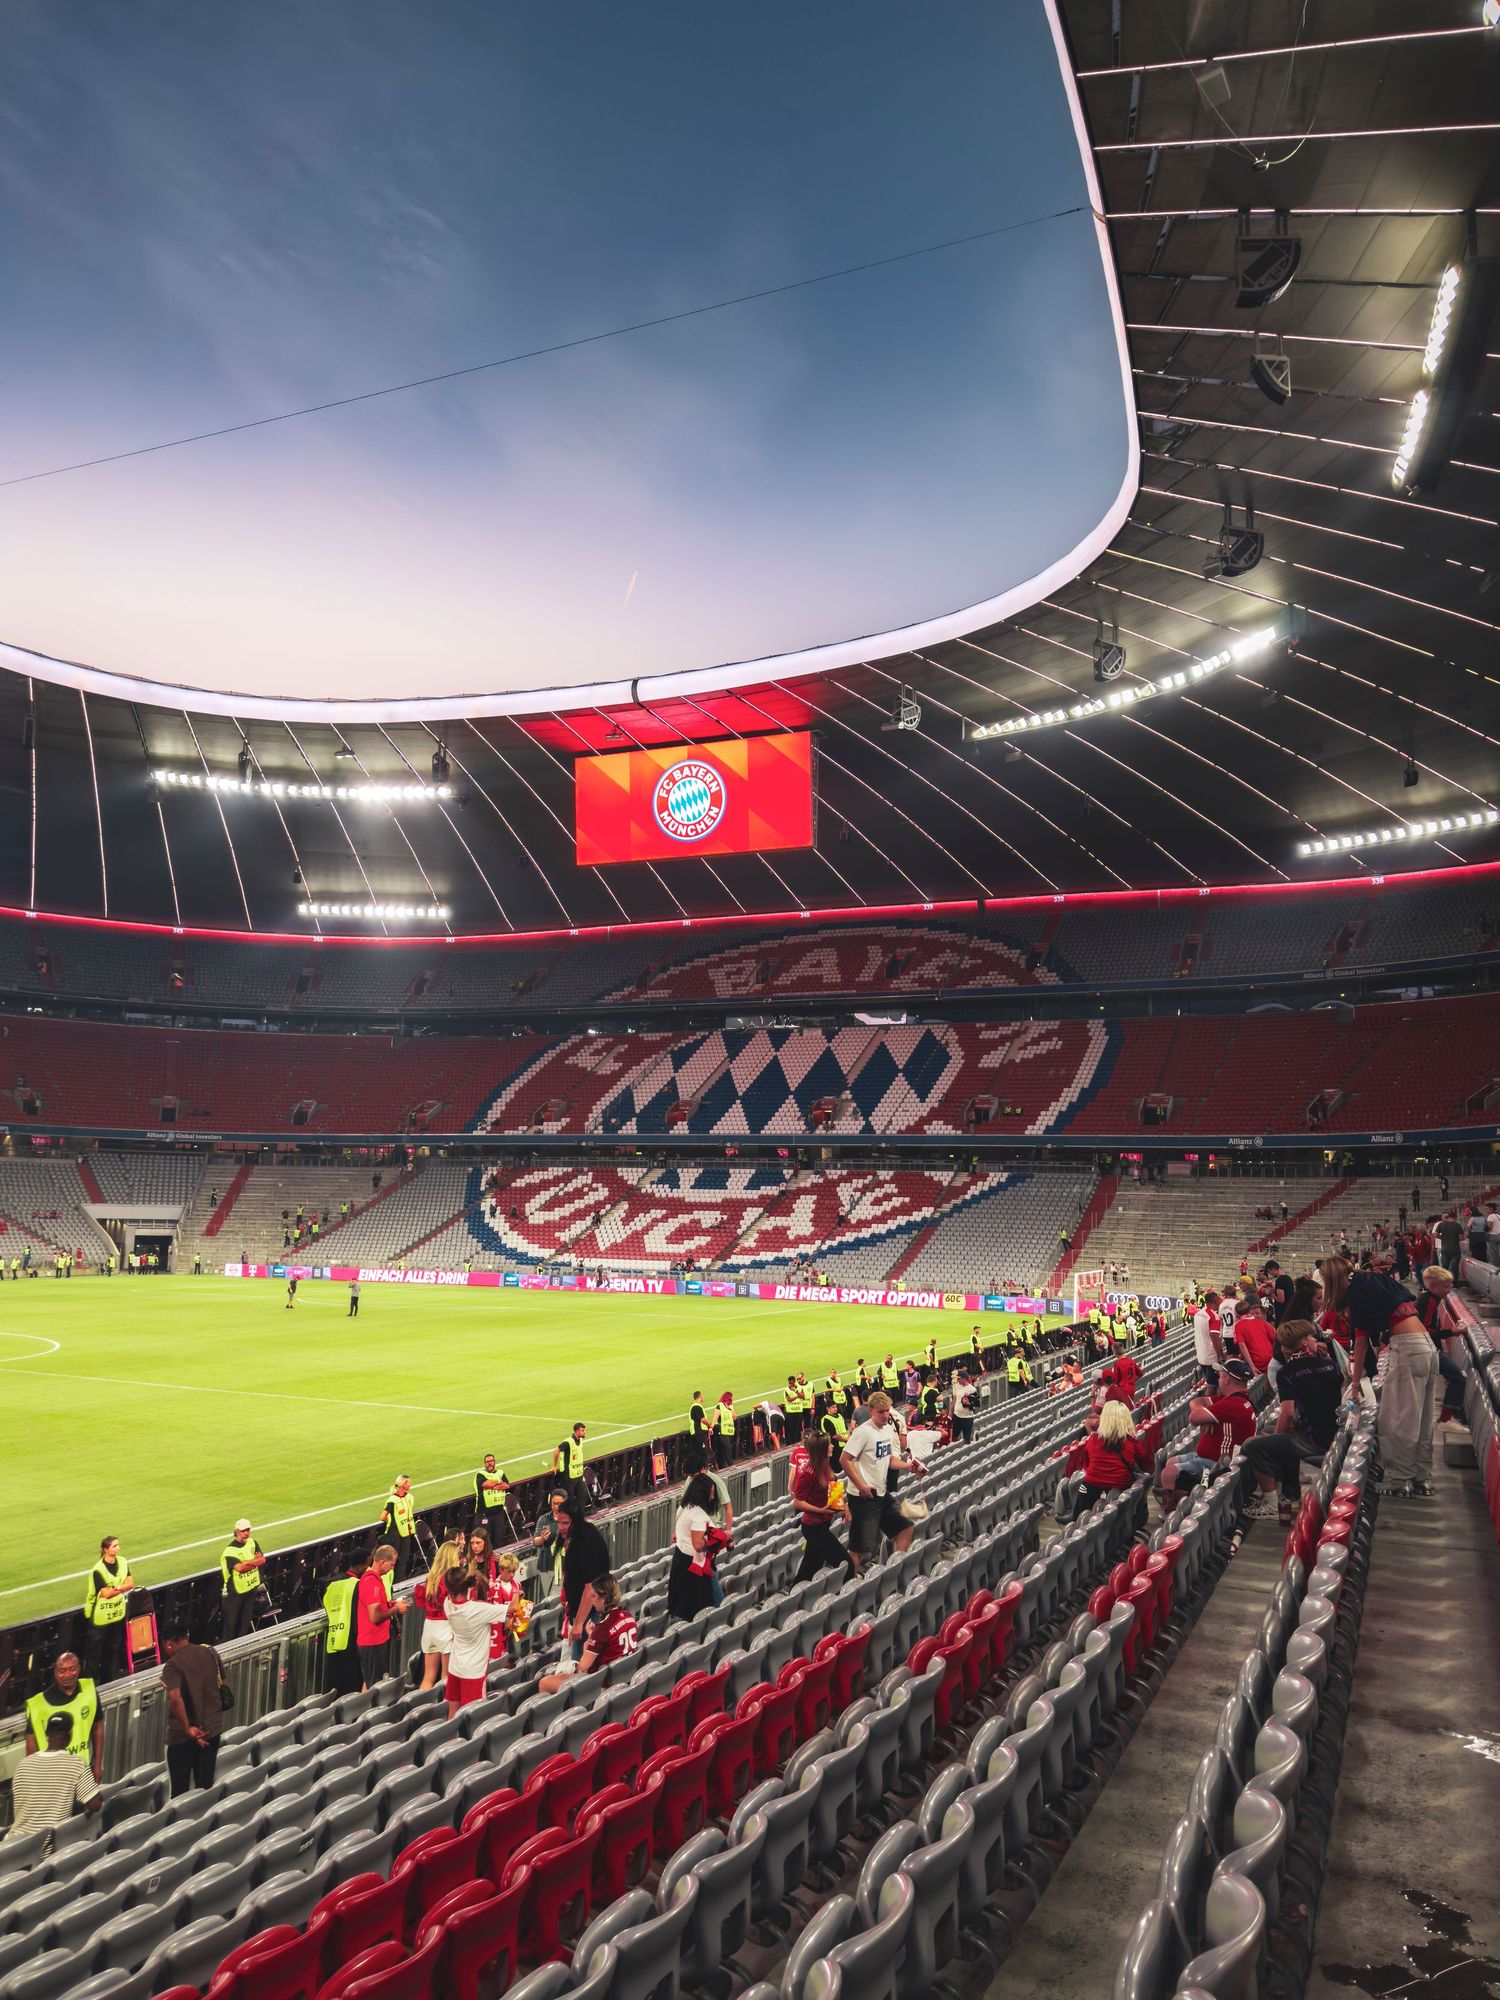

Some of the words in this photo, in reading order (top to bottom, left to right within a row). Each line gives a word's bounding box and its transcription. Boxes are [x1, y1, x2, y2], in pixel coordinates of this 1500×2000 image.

[659, 779, 673, 798] FC
[672, 765, 720, 793] BAYERN
[1303, 972, 1325, 980] Allianz
[1334, 969, 1356, 977] Global
[1356, 967, 1385, 975] Investors
[146, 1131, 167, 1139] Allianz
[1228, 1137, 1253, 1146] Allianz
[1370, 1134, 1394, 1143] Allianz
[358, 1269, 404, 1282] EINFACH
[404, 1270, 437, 1284] ALLES
[437, 1272, 469, 1285] DRIN!
[586, 1277, 648, 1292] MGENTA
[647, 1280, 664, 1293] TV
[775, 1286, 797, 1299] DIE
[799, 1287, 838, 1302] MEGA
[840, 1289, 885, 1304] SPORT
[887, 1291, 940, 1308] OPTION
